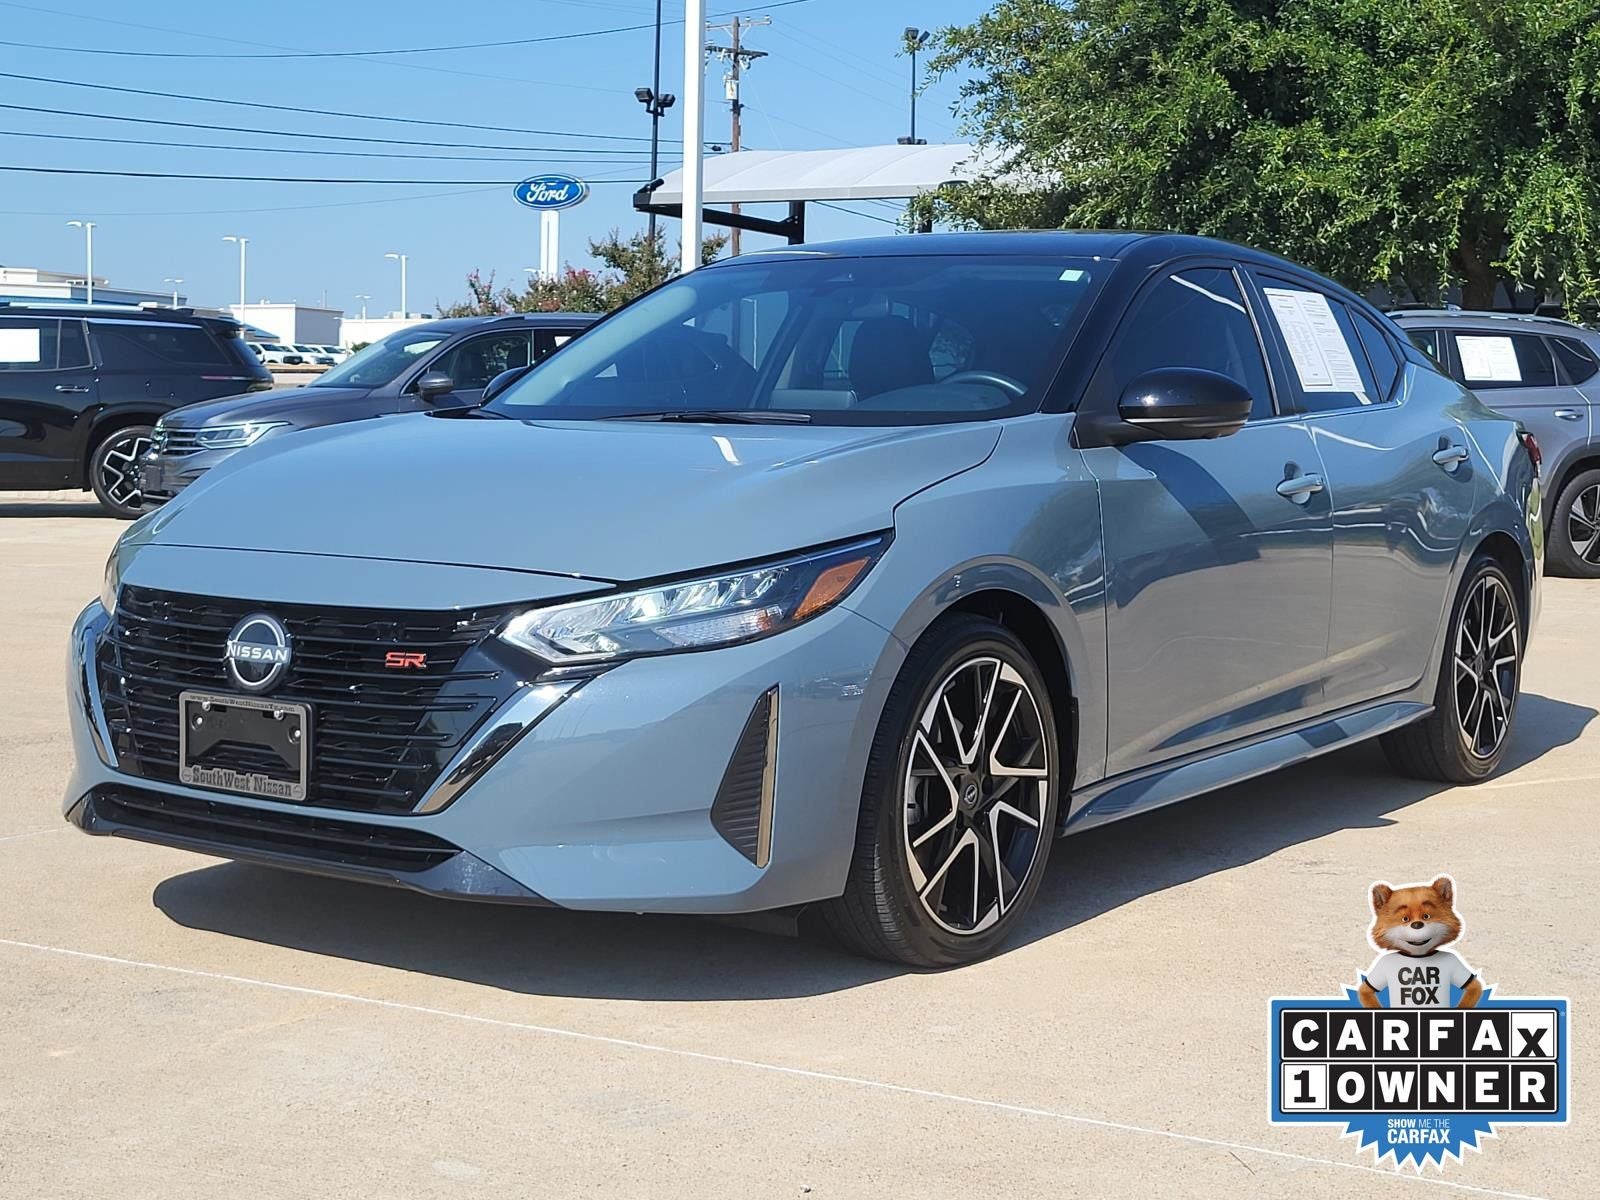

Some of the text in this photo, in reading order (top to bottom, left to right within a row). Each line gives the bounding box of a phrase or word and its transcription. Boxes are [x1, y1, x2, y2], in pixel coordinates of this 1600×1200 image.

[526, 181, 570, 202] Ford
[226, 641, 288, 661] NISSAN
[385, 651, 427, 668] SR
[253, 776, 292, 797] Nissan
